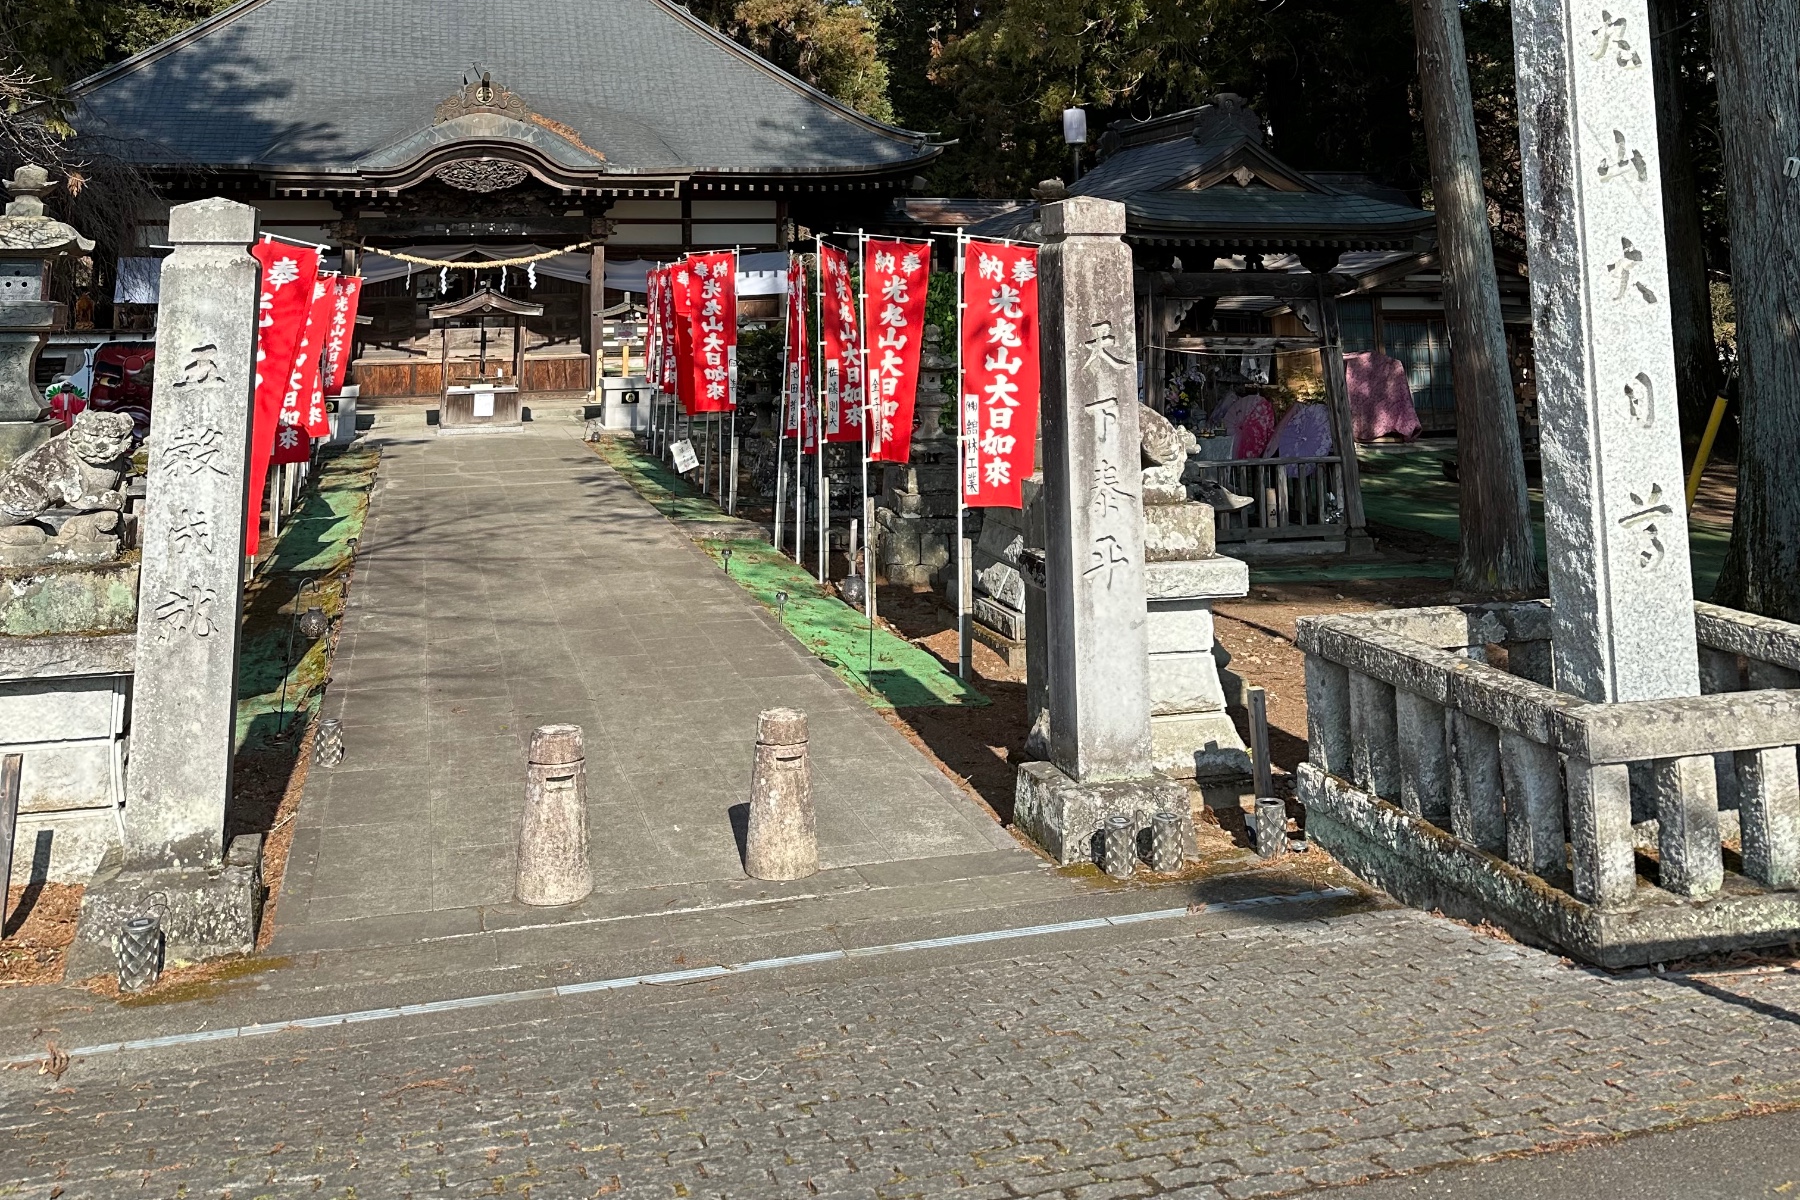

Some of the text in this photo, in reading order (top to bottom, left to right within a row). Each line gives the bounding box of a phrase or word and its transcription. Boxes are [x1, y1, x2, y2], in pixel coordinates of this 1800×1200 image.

[875, 250, 922, 277] 奉納
[978, 252, 1037, 288] 奉納
[980, 284, 1023, 487] 光丸山大日如來
[1081, 320, 1136, 591] 天下泰平
[155, 343, 229, 642] 五穀成就
